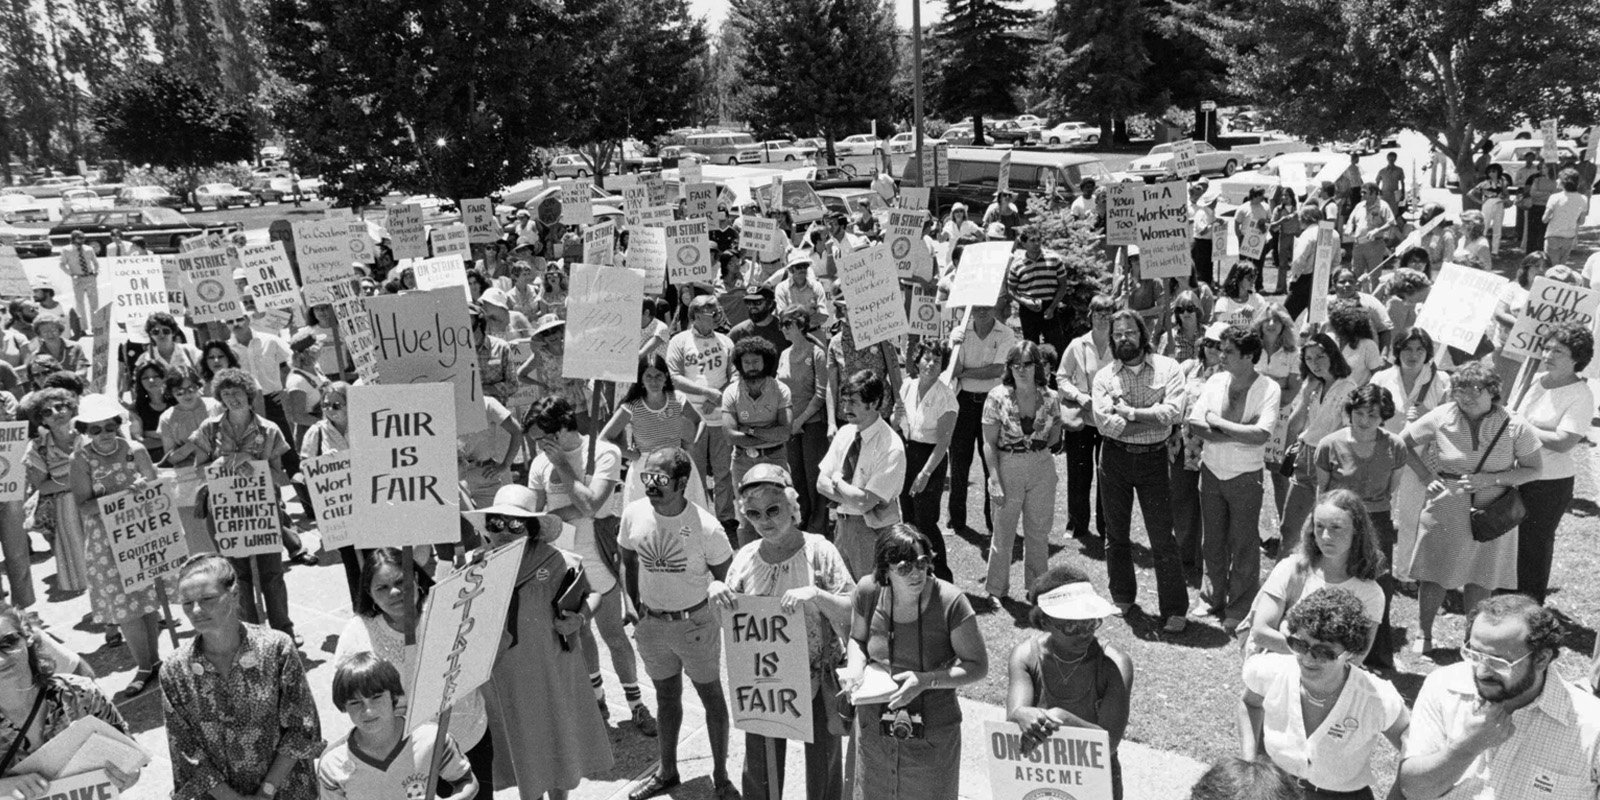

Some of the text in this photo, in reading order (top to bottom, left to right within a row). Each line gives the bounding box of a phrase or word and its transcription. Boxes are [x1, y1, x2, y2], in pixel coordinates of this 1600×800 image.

[690, 190, 712, 201] FAIR
[1162, 187, 1172, 199] A
[467, 204, 486, 213] FAIR
[697, 201, 706, 210] IS
[1109, 208, 1135, 218] BATTL
[1137, 204, 1187, 223] Working
[468, 222, 493, 233] FAIR!
[475, 215, 483, 223] IS
[890, 212, 925, 228] ON STRIKE
[595, 224, 612, 240] STRIKE
[666, 222, 707, 237] ON STRIKE
[1140, 226, 1187, 241] Woman
[244, 244, 276, 256] AFSCME
[179, 253, 227, 272] ON STRIKE
[245, 258, 267, 268] LOCAL
[417, 259, 462, 277] ON STRIKE
[191, 268, 221, 279] AFSCME
[259, 266, 276, 280] ON
[671, 266, 707, 277] AFL-CIO
[845, 266, 875, 287] County
[130, 277, 149, 290] ON
[252, 278, 293, 297] STRIKE
[855, 276, 890, 295] Workers
[117, 291, 166, 307] STRIKE
[1541, 285, 1588, 312] CITY
[194, 301, 236, 316] AFL-CIO
[854, 310, 895, 329] San Jose
[685, 343, 722, 367] Local
[700, 355, 722, 374] 715
[371, 408, 436, 438] FAIR
[0, 426, 26, 442] RIKE
[391, 446, 419, 469] IS
[213, 489, 267, 505] IS THE
[371, 473, 445, 505] FAIR
[104, 483, 163, 515] WE GOT
[325, 495, 336, 507] is
[215, 502, 276, 520] FEMINIST
[113, 512, 172, 544] FEVER
[217, 518, 276, 533] CAPITOL
[118, 531, 180, 563] EQUITABLE
[220, 537, 238, 550] OF
[138, 548, 167, 570] PAY
[125, 577, 134, 587] IS
[137, 573, 145, 582] A
[148, 563, 170, 578] SURE
[731, 613, 790, 644] FAIR
[754, 651, 779, 677] IS
[736, 685, 802, 719] FAIR
[991, 731, 1105, 769] ON STRIKE
[1015, 766, 1083, 785] AFSCME
